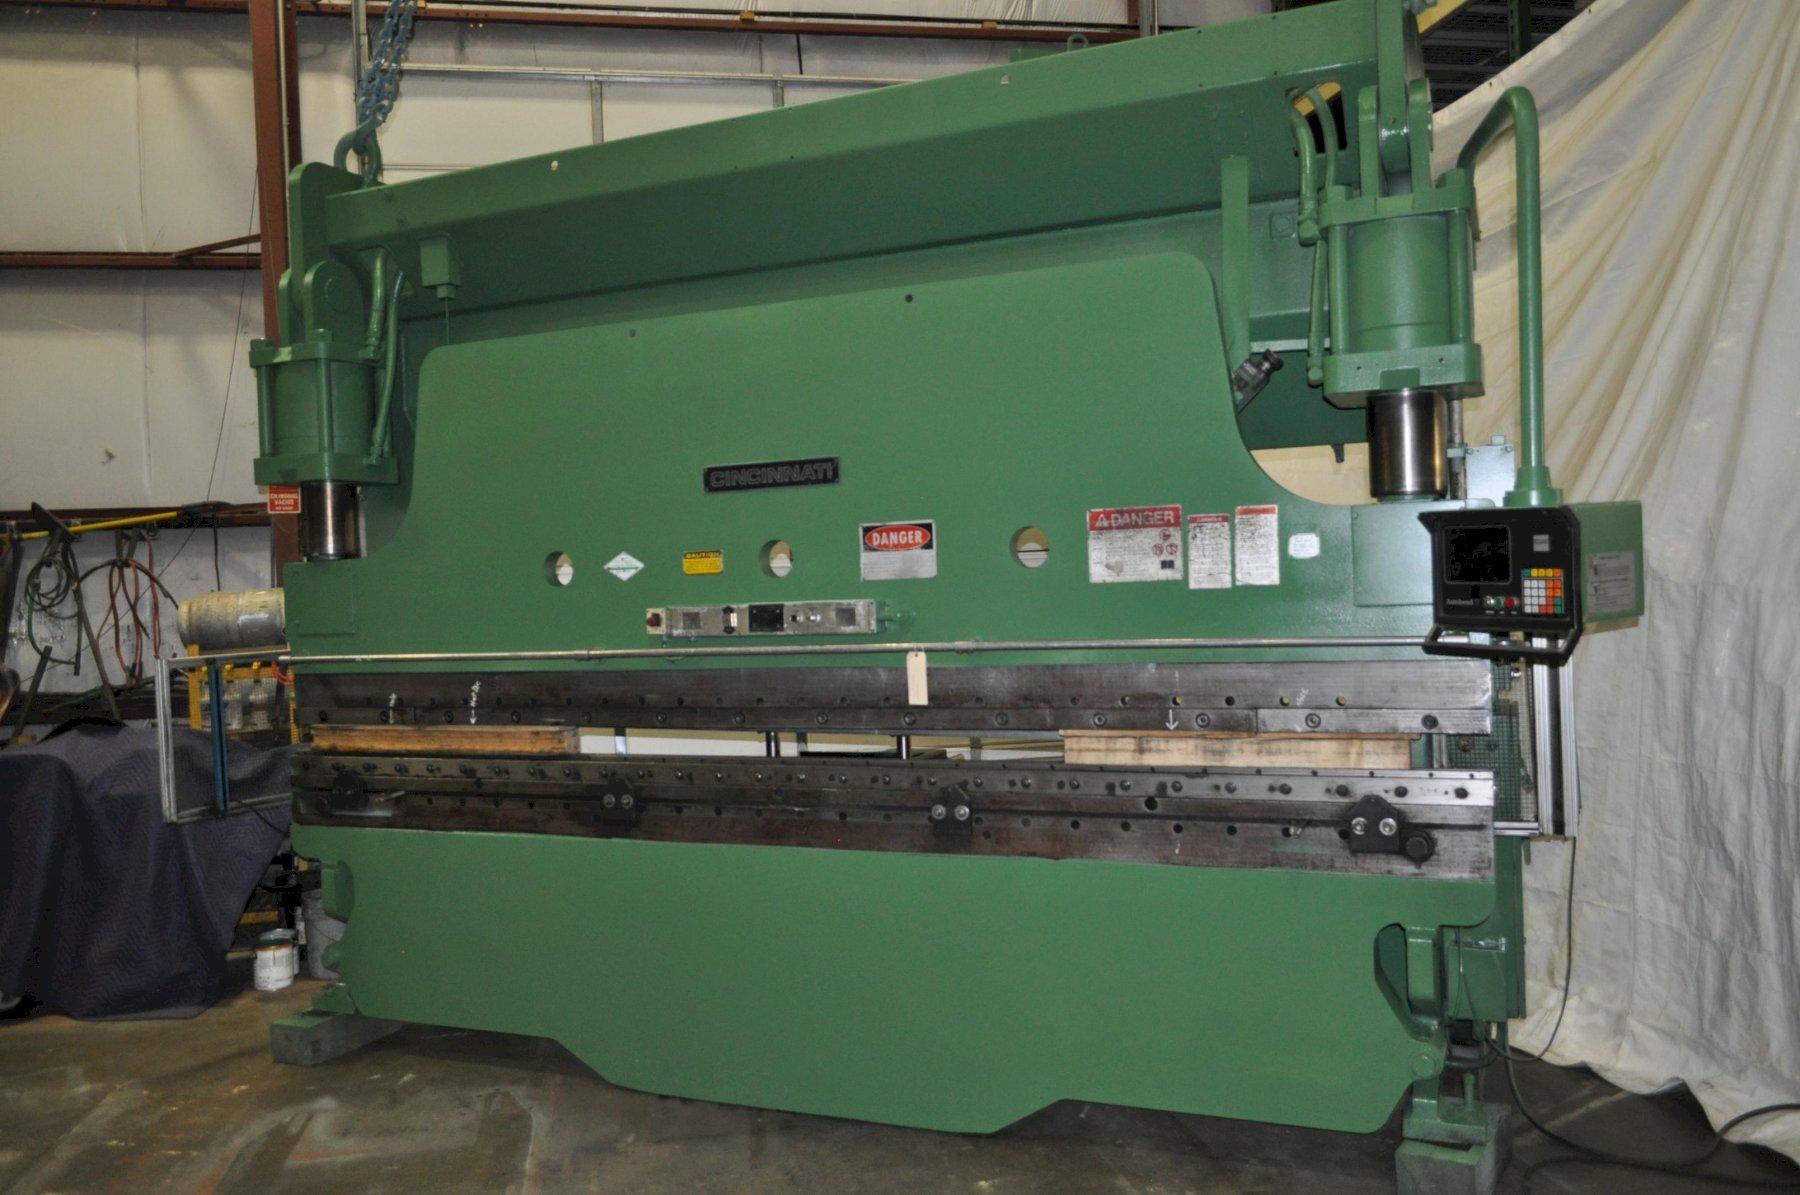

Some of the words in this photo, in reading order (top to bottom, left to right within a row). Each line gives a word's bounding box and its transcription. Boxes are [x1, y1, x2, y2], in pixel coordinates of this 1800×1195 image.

[710, 463, 834, 487] CINCINNATI
[1111, 510, 1174, 526] DANGER
[872, 530, 922, 545] DANGER
